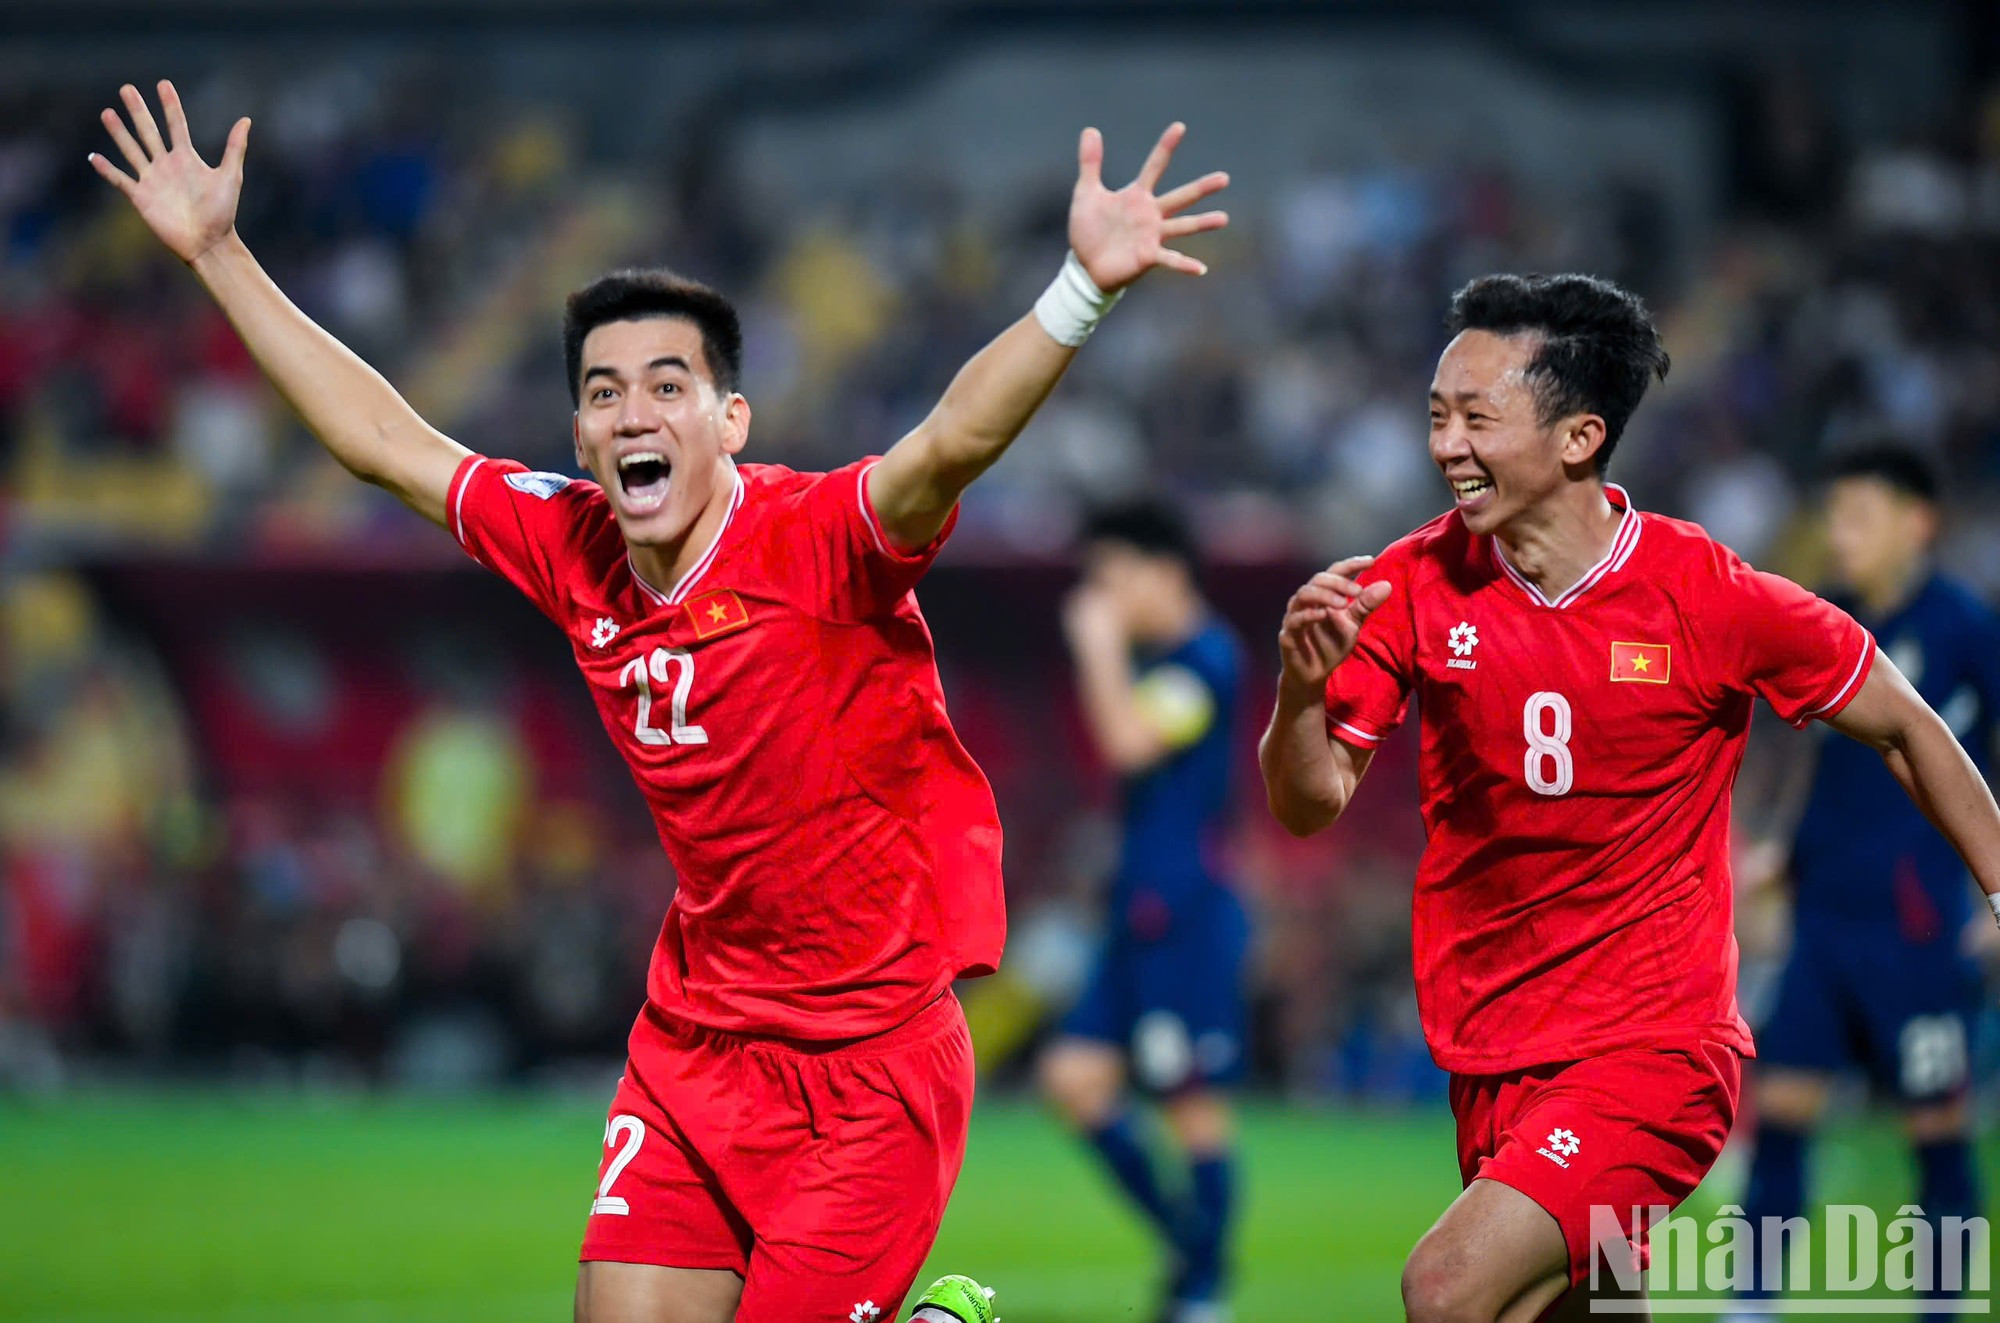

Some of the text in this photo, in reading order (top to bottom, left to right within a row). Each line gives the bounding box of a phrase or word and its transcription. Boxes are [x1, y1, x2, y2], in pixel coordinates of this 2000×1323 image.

[619, 647, 709, 746] 22
[1523, 691, 1574, 796] 8
[590, 1114, 646, 1216] 2
